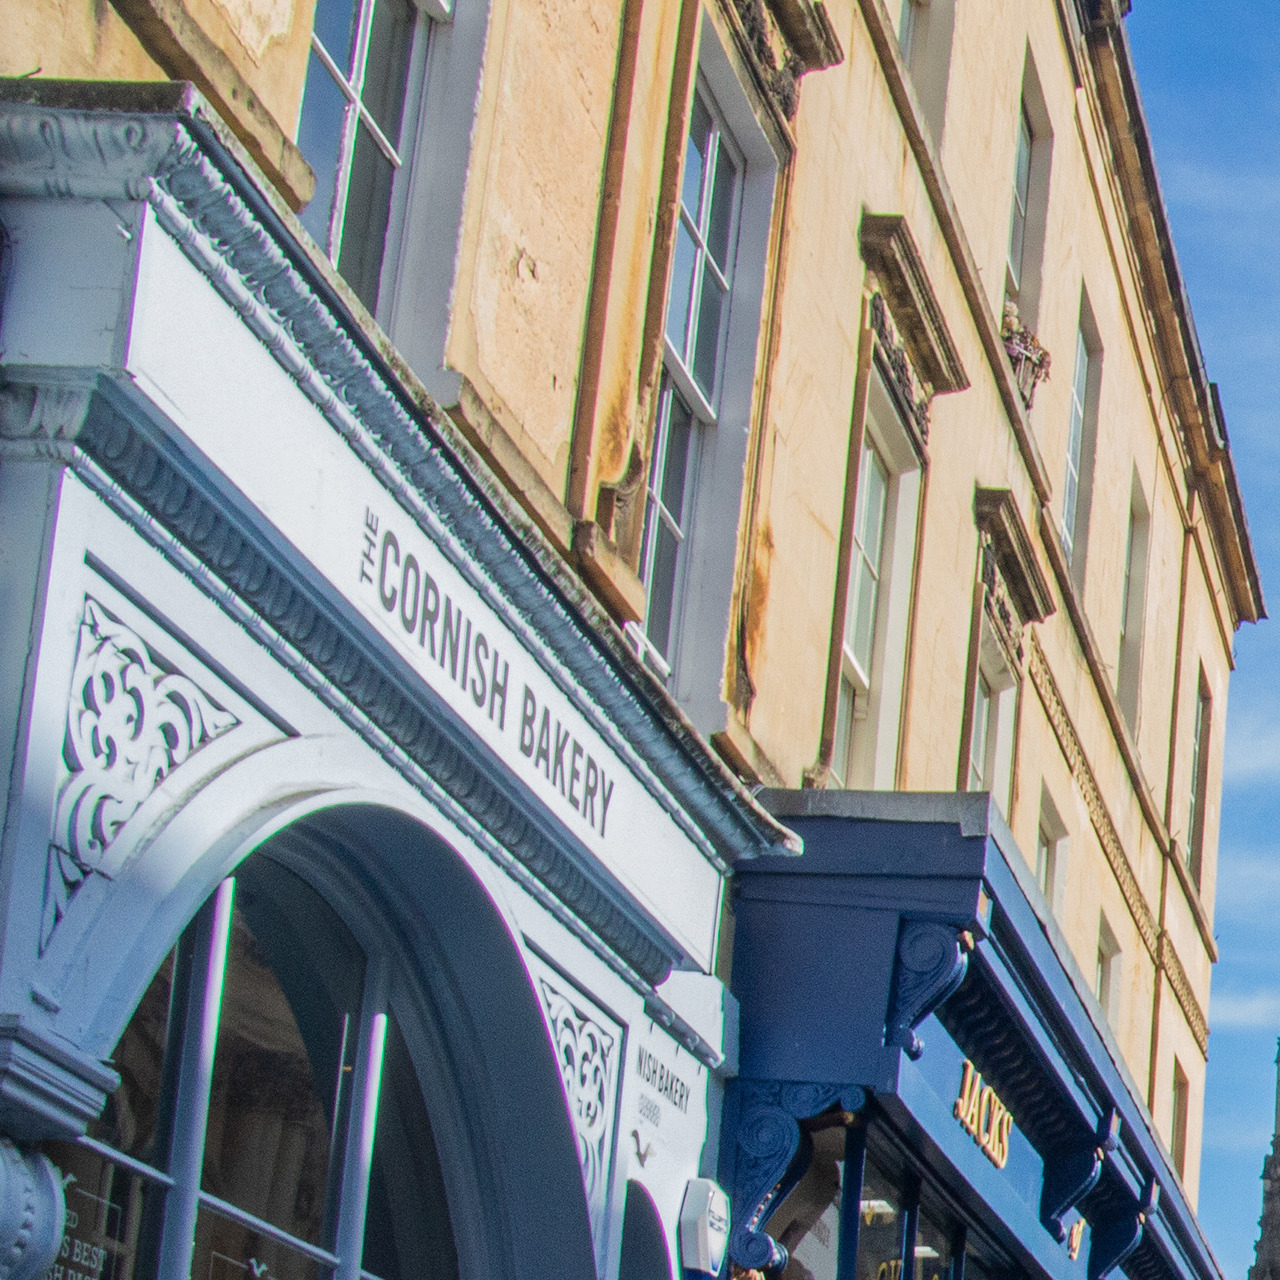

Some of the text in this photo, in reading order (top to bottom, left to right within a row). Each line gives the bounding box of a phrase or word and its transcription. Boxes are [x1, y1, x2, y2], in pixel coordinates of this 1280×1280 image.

[360, 507, 379, 585] THE
[379, 529, 615, 838] CORNISH BAKERY
[636, 1043, 659, 1089] NISH
[658, 1063, 691, 1115] BAKERY
[953, 1057, 1014, 1171] JACKS
[71, 1239, 108, 1272] BEST
